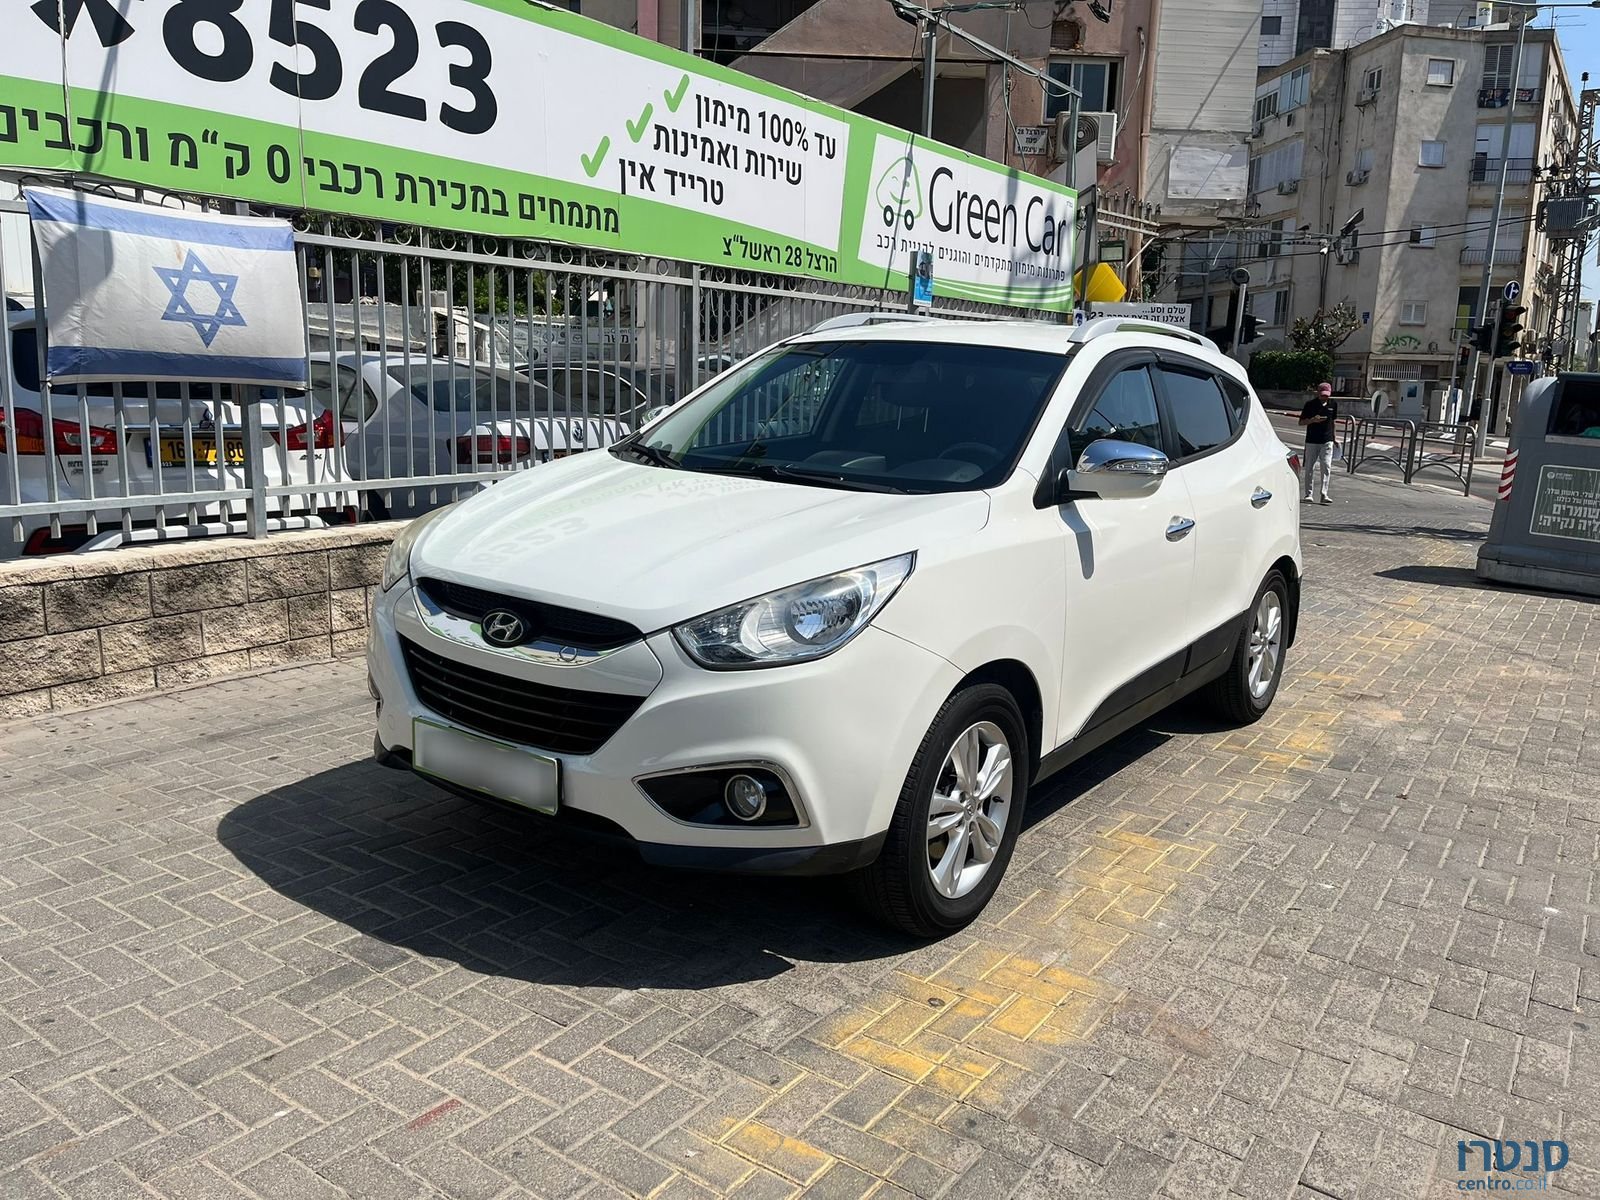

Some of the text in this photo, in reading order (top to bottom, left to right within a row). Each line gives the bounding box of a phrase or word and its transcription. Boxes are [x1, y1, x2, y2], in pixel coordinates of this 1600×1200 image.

[695, 93, 837, 160] עד 100% מימון
[266, 144, 291, 184] 0
[653, 123, 802, 186] שירות ואמינות
[303, 158, 384, 200] רכבי
[394, 170, 510, 218] במכירת
[618, 157, 724, 206] טרייד אין
[518, 190, 620, 234] מתמחים
[929, 166, 1067, 257] Green Car
[784, 245, 803, 268] 28
[806, 248, 838, 273] הרצל
[938, 245, 971, 265] והוגנים
[974, 254, 1012, 273] מתקדמים
[1014, 261, 1035, 277] מימון
[1162, 315, 1185, 323] אצלנו
[1167, 306, 1186, 315] שלם
